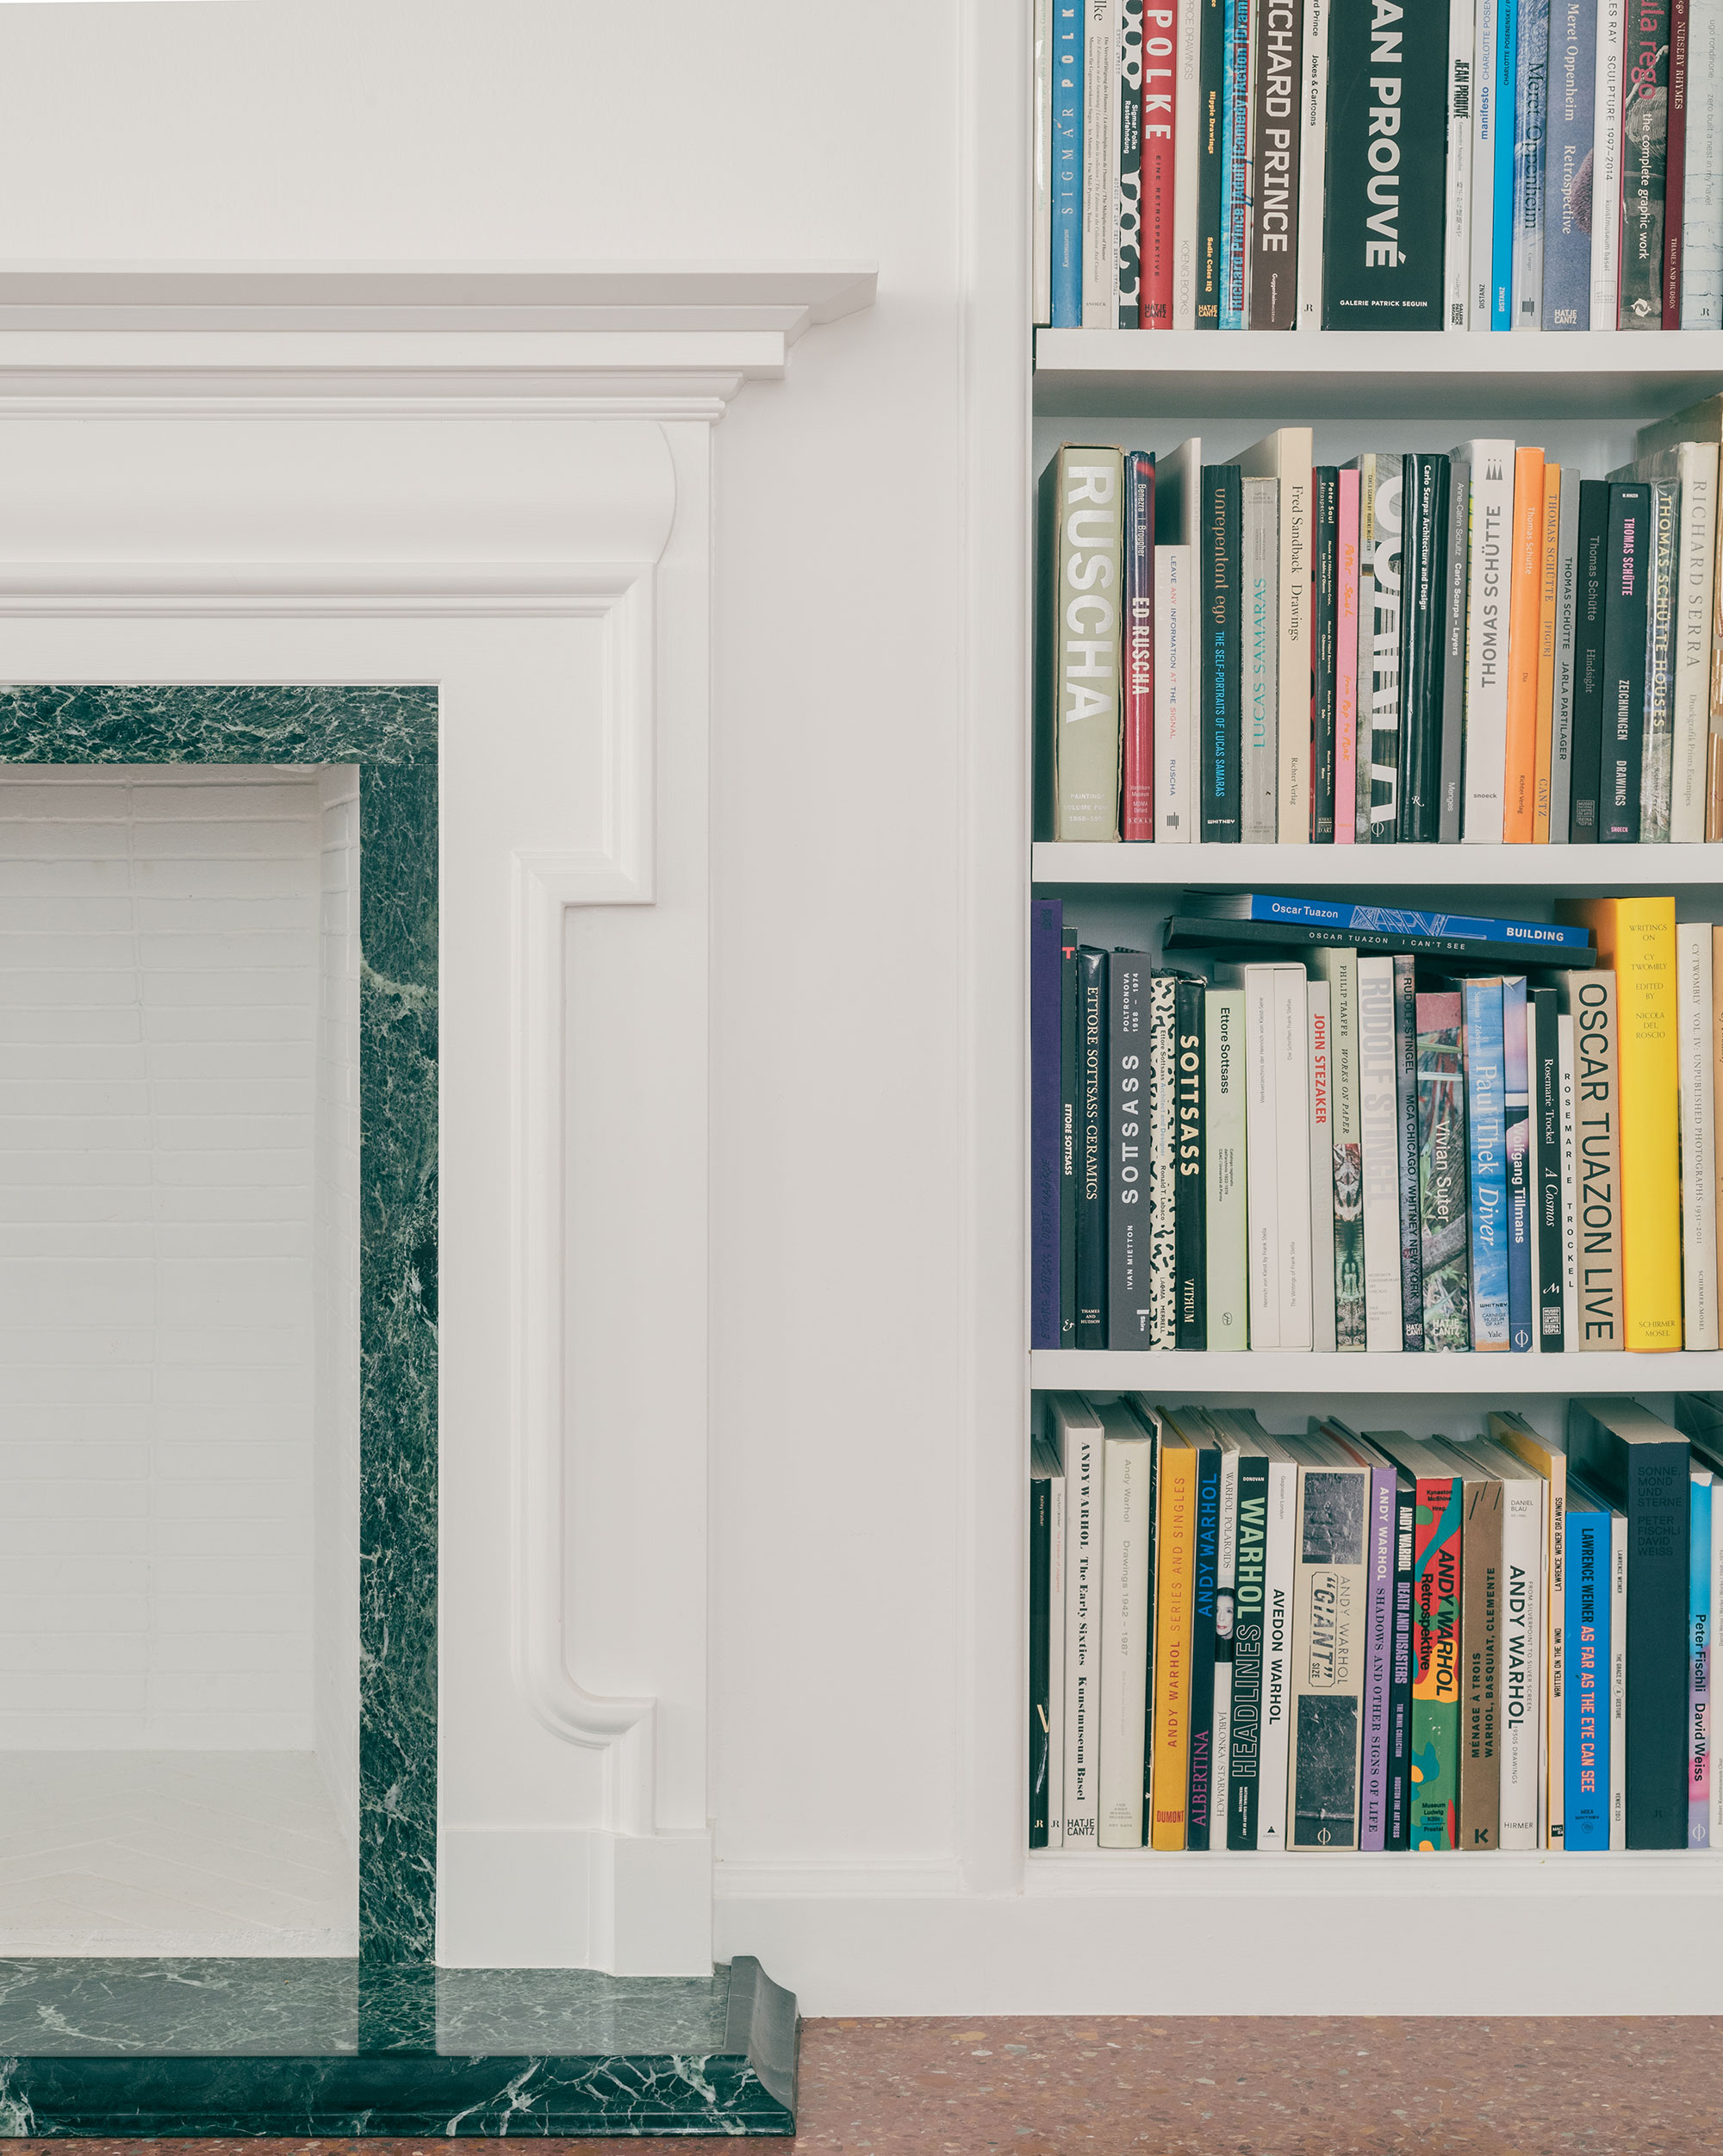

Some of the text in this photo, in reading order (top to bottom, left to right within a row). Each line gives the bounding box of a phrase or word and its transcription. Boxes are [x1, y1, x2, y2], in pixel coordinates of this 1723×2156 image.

[1145, 9, 1172, 139] POLKE
[1309, 89, 1318, 126] Cartoons
[1454, 59, 1471, 119] JEAN PROUVÉ
[1564, 3, 1579, 122] Meret Oppenheim
[1607, 56, 1616, 122] SCULPTURE
[1631, 41, 1657, 99] rego
[1675, 22, 1685, 109] NURSERY RHYMES
[1480, 86, 1490, 140] manifesto
[1263, 128, 1290, 252] PRINCE
[1365, 78, 1407, 267] PROUVÉ
[1561, 146, 1576, 234] Retrospective
[1638, 114, 1651, 259] the complete graphic work
[1205, 281, 1212, 291] HQ
[1136, 483, 1147, 557] Benezra Brougher
[1421, 487, 1429, 515] Scarpa:
[1422, 465, 1431, 484] Carlo
[1212, 489, 1229, 624] unrepentant ego
[1291, 486, 1304, 573] Fred Sandback
[1421, 518, 1429, 565] Architecture
[1622, 518, 1635, 595] THOMAS SCHÜTTE
[1066, 465, 1115, 724] RUSCHA
[1289, 584, 1303, 640] Drawings
[1419, 583, 1428, 610] Design
[1482, 505, 1501, 688] THOMAS SCHÜTTE
[1562, 557, 1572, 649] THOMAS SCHÜTTE
[1132, 597, 1149, 695] ED RUSCHA
[1170, 672, 1176, 682] AT
[1216, 632, 1225, 797] THE SELF-PORTRAITS OF LUCAS SAMARAS
[1558, 662, 1570, 760] JARLA PARTILAGER
[1617, 680, 1630, 740] ZEICHNUNGEN
[1289, 784, 1297, 805] Verlag
[1615, 760, 1627, 806] DRAWINGS
[1271, 902, 1340, 919] Oscar Tuazon
[1309, 932, 1389, 944] OSCAR TUAZON
[1506, 926, 1564, 942] BUILDING
[1085, 986, 1099, 1044] ETTORE
[1220, 1007, 1230, 1094] Ettore Sottsass
[1180, 1035, 1199, 1175] SOTTSASS
[1314, 1013, 1327, 1124] JOHN STEZAKER
[1341, 1087, 1349, 1100] ON
[1544, 1058, 1555, 1144] Rosemarie Trockel
[1064, 1137, 1073, 1175] SOTTSASS
[1122, 1056, 1140, 1203] SOTTSASS
[1434, 1120, 1452, 1222] Vivian Suter
[1475, 1064, 1499, 1245] Paul Thek Diver
[1579, 983, 1614, 1340] OSCAR TUAZON LIVE
[1545, 1168, 1558, 1227] A Cosmos
[1078, 1443, 1090, 1666] ANDY WARHOL The Early Sixties
[1199, 1474, 1216, 1617] ANDY WARHOL
[1378, 1486, 1389, 1581] ANDY WARHOL
[1398, 1506, 1411, 1572] ANDY WARHOL
[1582, 1529, 1594, 1623] LAWRENCE WEINER
[1232, 1497, 1265, 1777] WARHOL HEADLINES
[1269, 1589, 1284, 1724] AVEDON WARHOL
[1338, 1576, 1350, 1685] ANDY WARHOL
[1395, 1582, 1410, 1684] DEATH AND DISASTERS
[1420, 1573, 1434, 1670] Retrospektive
[1436, 1549, 1454, 1696] ANDY WARHOL
[1508, 1566, 1525, 1729] ANDY WARHOL
[1694, 1614, 1707, 1692] Peter Fischli
[1077, 1677, 1087, 1800] Kunstmuseum Basel
[1370, 1588, 1385, 1833] SHADOWS AND OTHER SIGNS OF LIFE
[1582, 1626, 1594, 1792] AS FAR AS THE EYE CAN SEE
[1694, 1703, 1706, 1782] David Weiss
[1191, 1731, 1209, 1826] ALBERTINA
